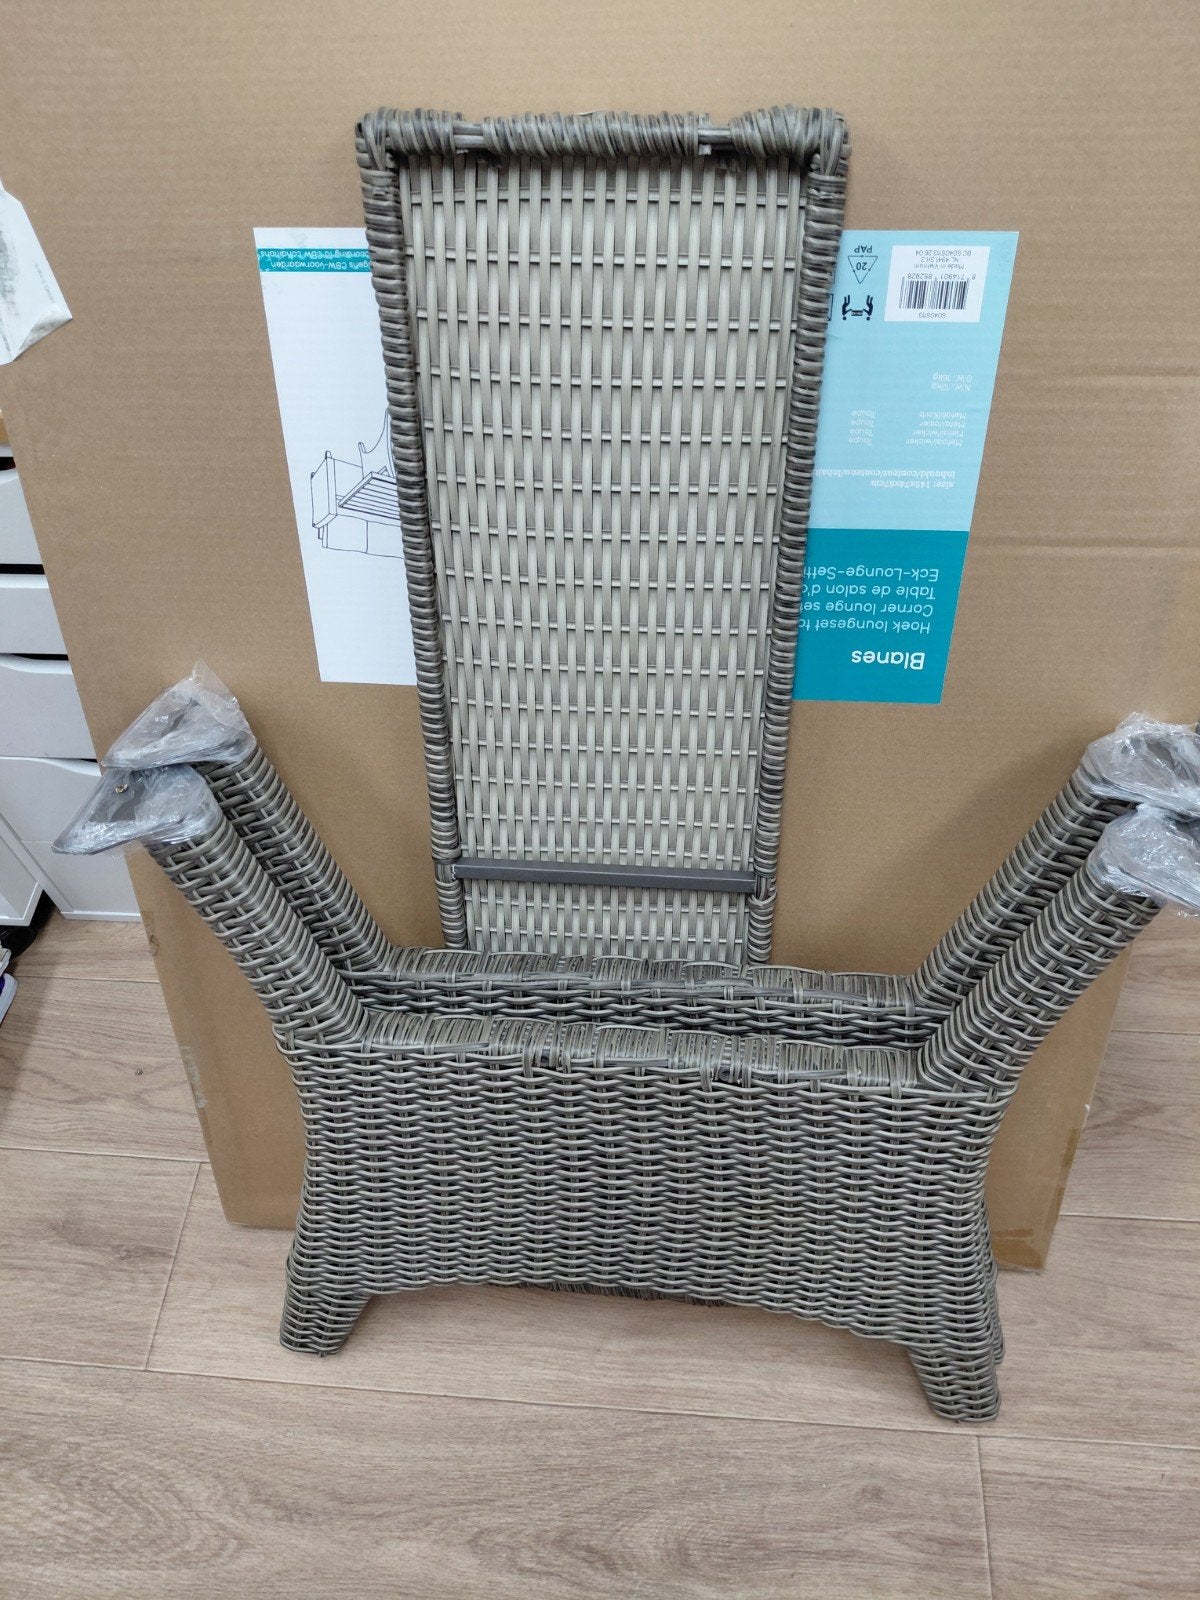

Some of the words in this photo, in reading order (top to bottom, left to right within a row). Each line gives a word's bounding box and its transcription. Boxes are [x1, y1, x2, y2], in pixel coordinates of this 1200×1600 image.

[854, 245, 872, 253] PAP
[270, 262, 347, 270] CBW-voorwaarden
[856, 261, 868, 270] 20
[851, 409, 875, 419] Taupe
[850, 418, 874, 427] Taupe
[849, 426, 873, 436] Taupe
[912, 430, 963, 438] Metal/wicker
[848, 435, 872, 445] Taupe
[905, 438, 963, 446] Metaal/wicker
[871, 480, 929, 488] 145x74x67cm
[803, 565, 938, 582] Eck-Lounge-Setti
[826, 585, 866, 597] salon
[872, 586, 890, 598] de
[896, 586, 935, 599] Table
[826, 600, 875, 615] lounge
[881, 604, 933, 616] Corner
[815, 618, 888, 632] loungeset
[892, 621, 930, 634] Hoek
[851, 651, 925, 670] Blanes
